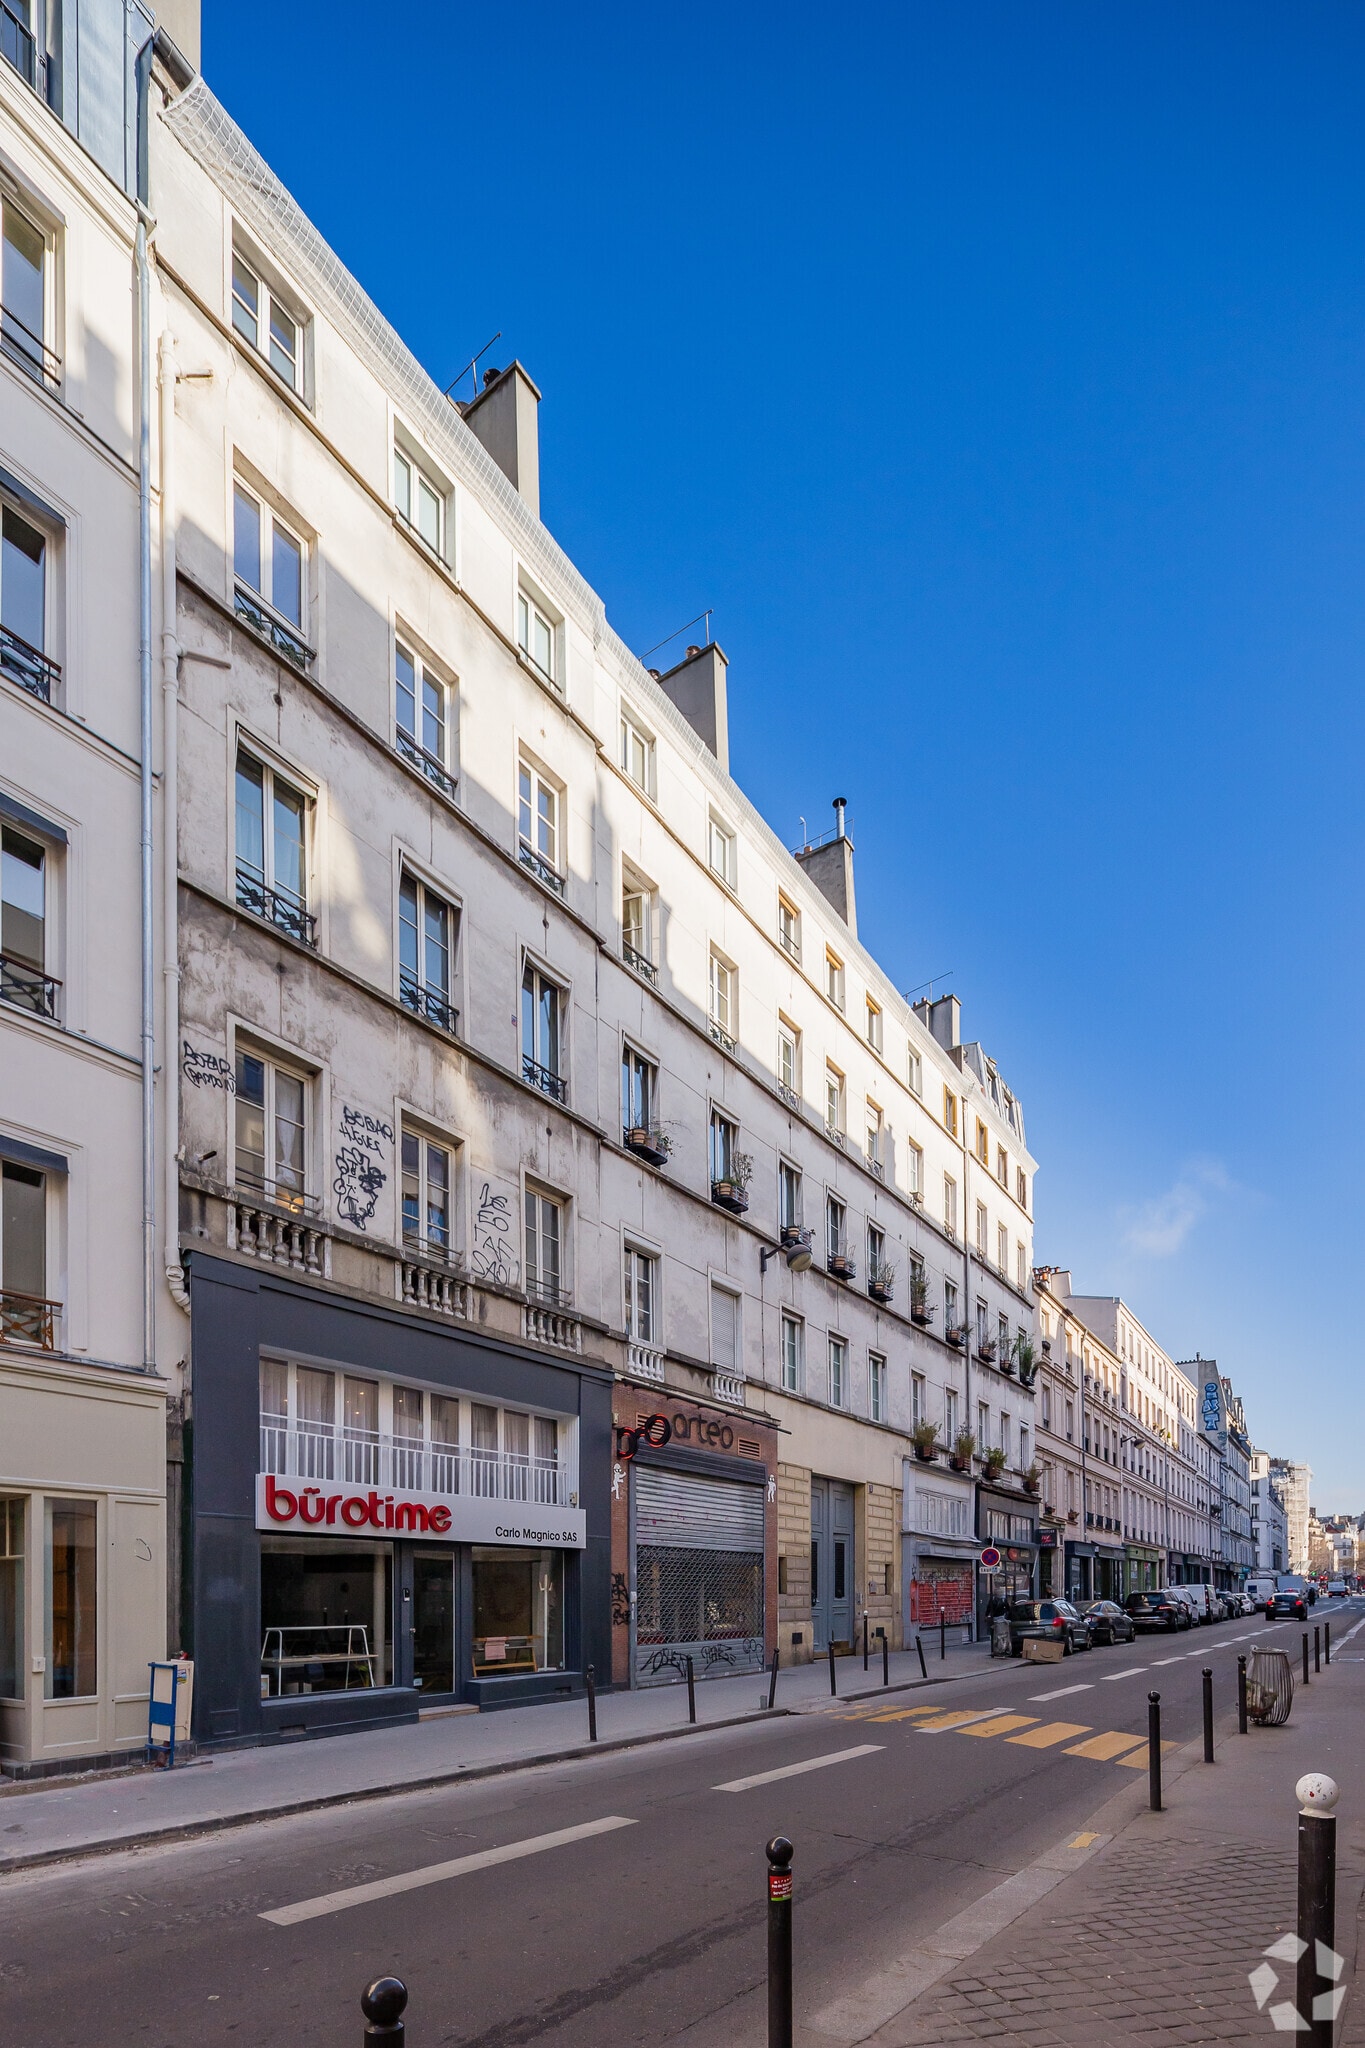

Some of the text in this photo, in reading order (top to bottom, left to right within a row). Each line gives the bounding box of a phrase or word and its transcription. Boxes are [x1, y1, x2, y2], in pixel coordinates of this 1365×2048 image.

[265, 1475, 452, 1532] bürotime
[495, 1526, 577, 1542] Carlo Magnico SAS
